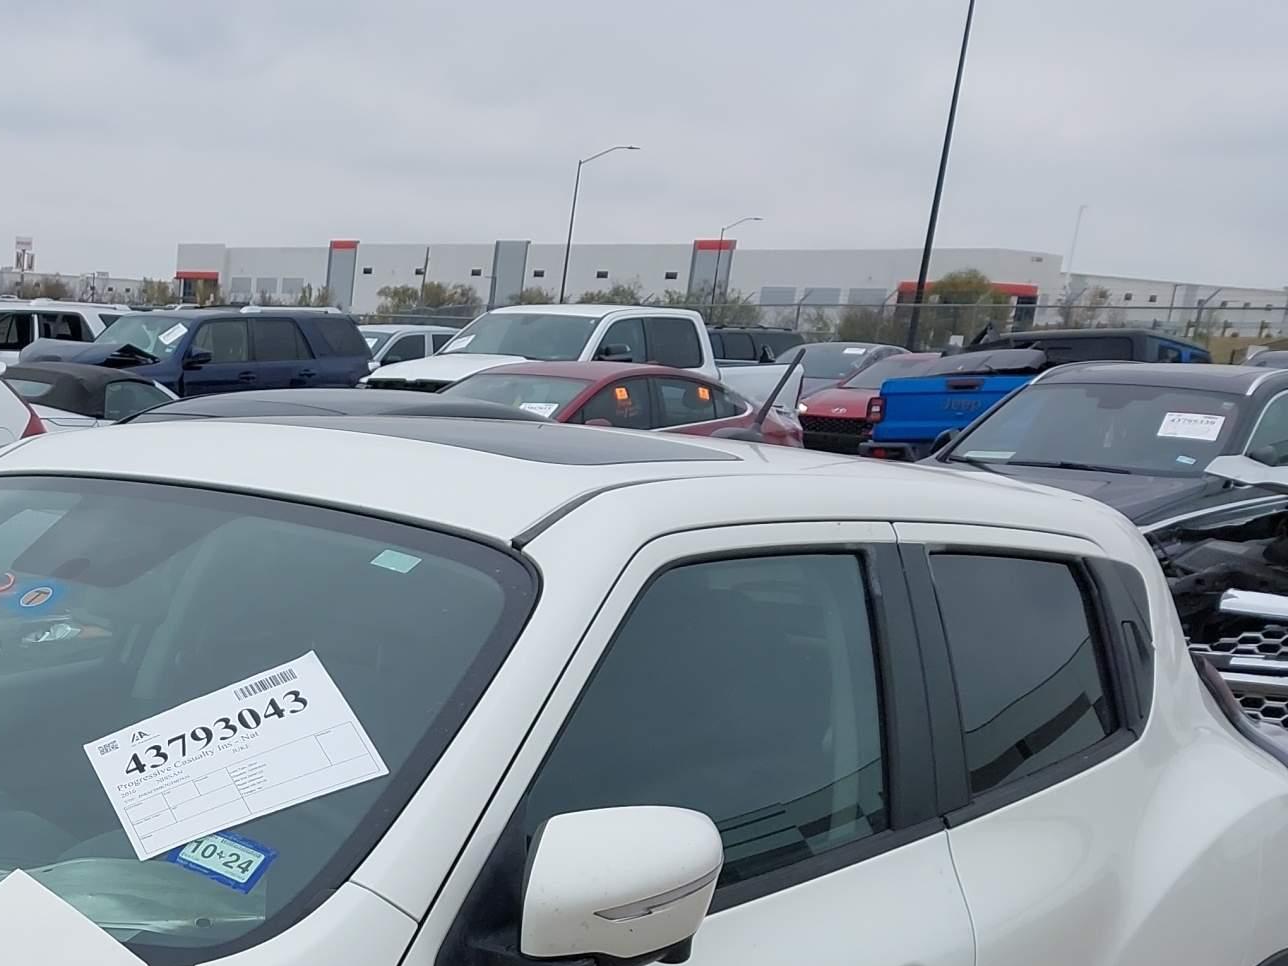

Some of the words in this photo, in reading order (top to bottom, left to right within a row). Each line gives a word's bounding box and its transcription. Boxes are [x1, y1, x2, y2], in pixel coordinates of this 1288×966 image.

[116, 765, 172, 792] Progressive
[173, 748, 215, 768] Casualty
[216, 741, 233, 752] Ins
[240, 730, 260, 742] Nat
[124, 690, 309, 775] 43793043
